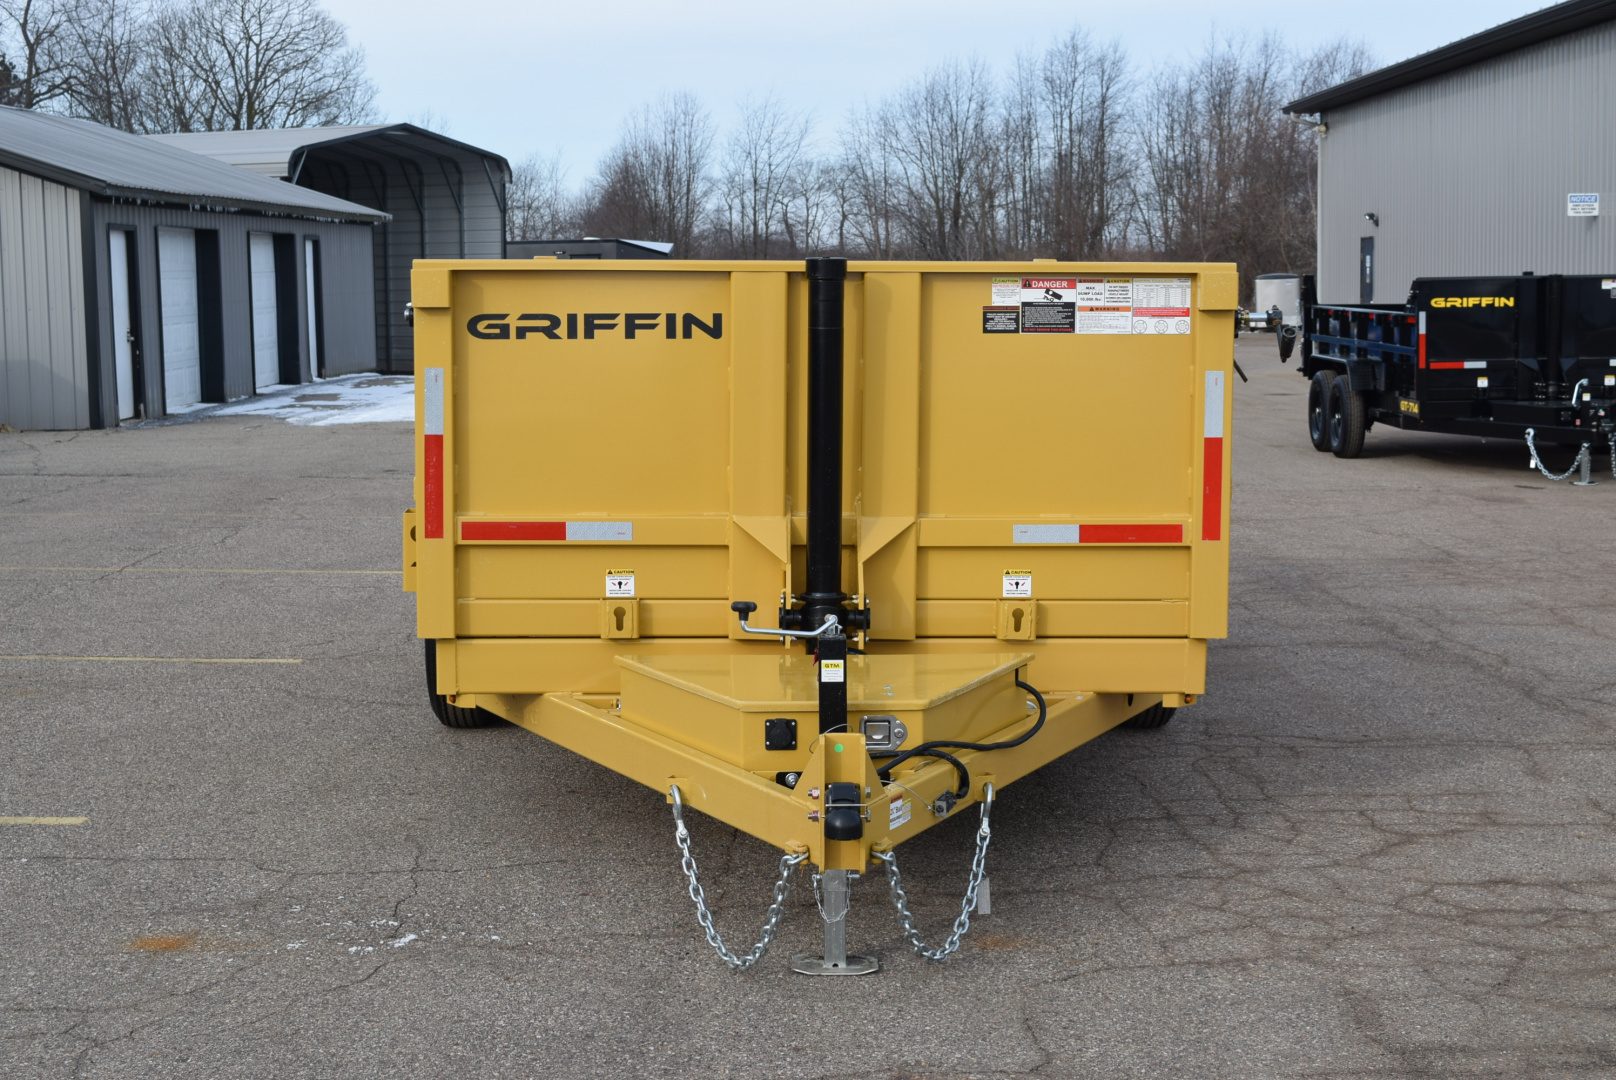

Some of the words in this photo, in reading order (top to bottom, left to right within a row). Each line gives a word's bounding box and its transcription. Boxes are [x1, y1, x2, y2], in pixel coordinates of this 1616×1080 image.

[1430, 297, 1514, 308] GRIFFIN
[466, 313, 722, 340] GRIFFIN
[1400, 400, 1419, 414] GT-714
